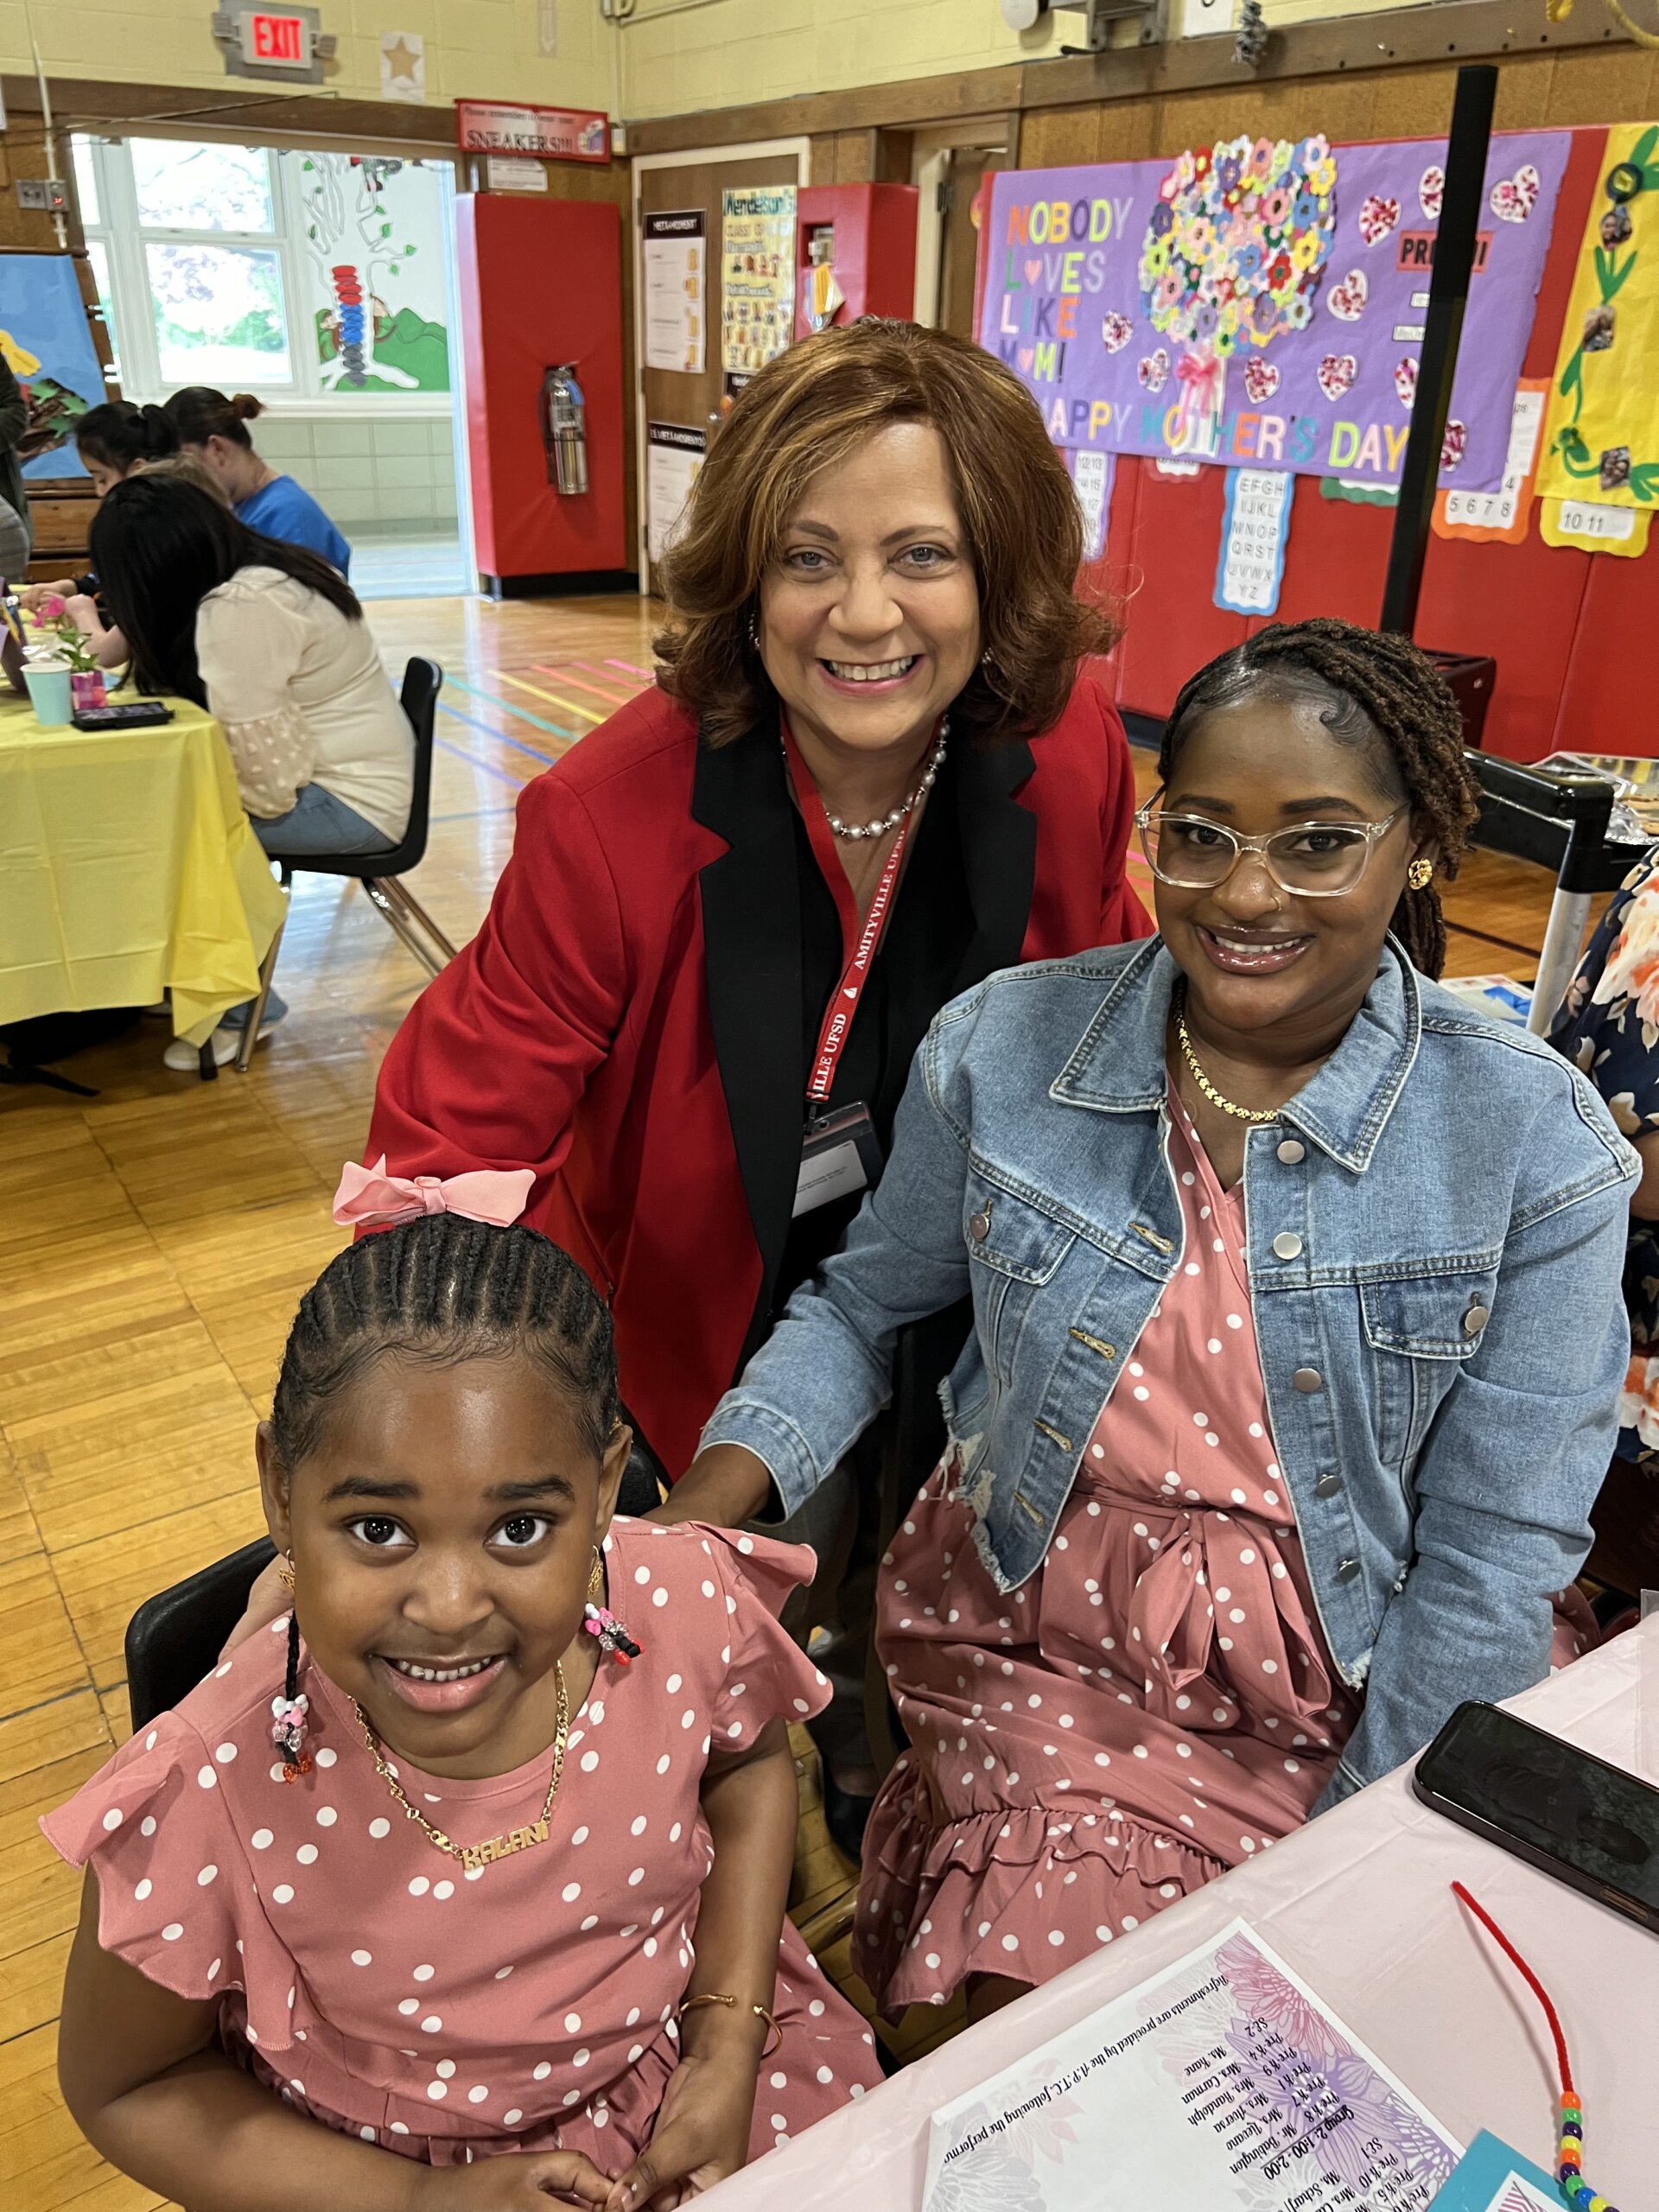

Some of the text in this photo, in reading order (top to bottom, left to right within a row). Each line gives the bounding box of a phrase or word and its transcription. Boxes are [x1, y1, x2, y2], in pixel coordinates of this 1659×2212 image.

[253, 14, 302, 61] EXIT
[467, 130, 573, 154] SNEAKERS!!!
[1007, 197, 1134, 245] NOBODY
[1000, 294, 1080, 339] LIKE
[1327, 421, 1411, 472] DAY
[1449, 498, 1511, 518] 5 6 7 8
[1564, 513, 1605, 533] 10 11
[854, 874, 894, 970] AMITYVILLE
[823, 1013, 847, 1053] UFSD
[462, 1820, 549, 1871] KALANI
[1170, 1974, 1229, 2015] Refreshments
[1156, 2010, 1172, 2024] are
[1116, 2016, 1157, 2052] provided
[1090, 2053, 1106, 2067] the
[1103, 2045, 1119, 2058] by
[1184, 2056, 1211, 2076] Kane
[1206, 2046, 1226, 2059] Ms.
[1180, 2031, 1282, 2104] Pre-K 4 Mrs. Carman
[1281, 2061, 1312, 2088] Pre-K
[1186, 2046, 1297, 2126] Pre-K 9 Mrs. Randolph
[1244, 2092, 1269, 2109] Mrs.
[1002, 2085, 1052, 2124] following
[1212, 2104, 1247, 2133] Aversa
[1225, 2075, 1326, 2151] Pre-K 7 Mrs. Lievano
[1320, 2103, 1355, 2132] Group
[988, 2119, 1006, 2133] the
[1229, 2090, 1340, 2174] Pre-K 8 Mr. Babington
[1313, 2125, 1328, 2139] 2:
[1290, 2135, 1315, 2158] 1:00
[1262, 2154, 1290, 2180] 2:00
[1319, 2169, 1340, 2185] Ms.
[1330, 2152, 1399, 2204] Pre-K 10 Mrs.
[1376, 2168, 1414, 2202] Pre-K 5
